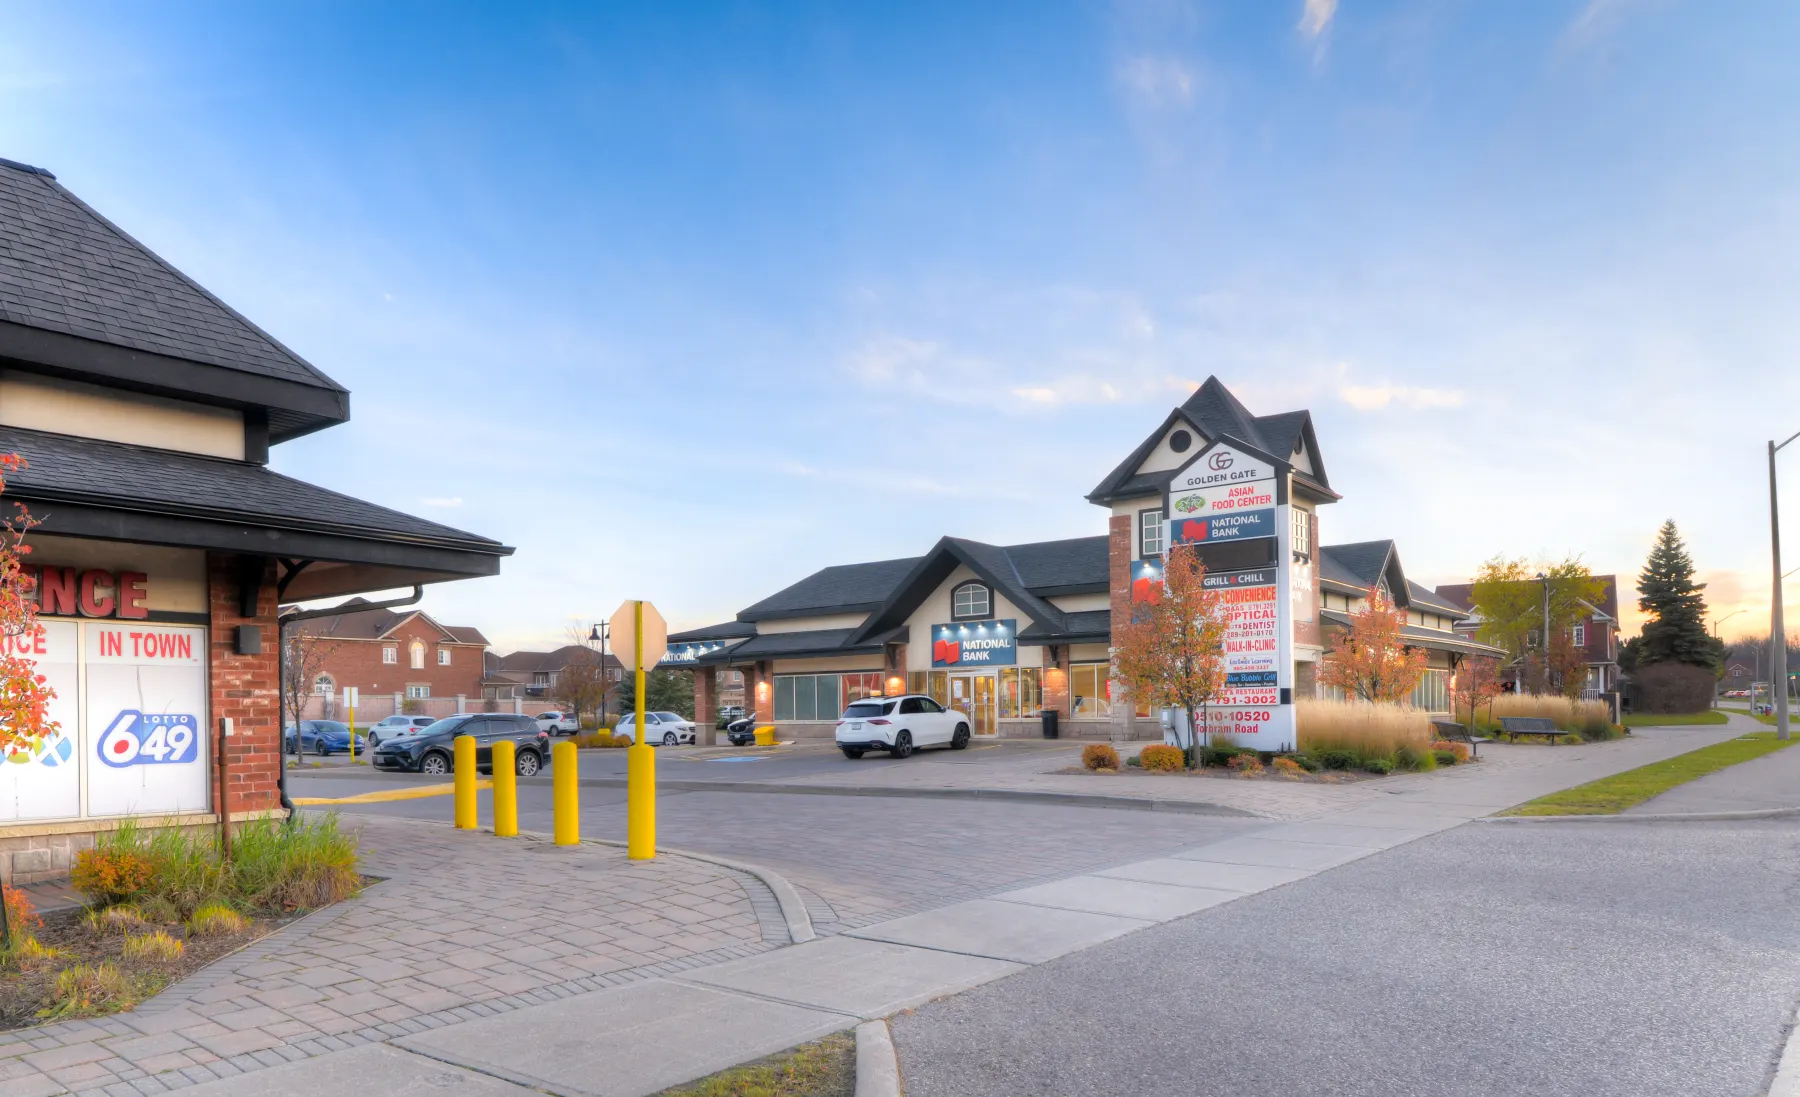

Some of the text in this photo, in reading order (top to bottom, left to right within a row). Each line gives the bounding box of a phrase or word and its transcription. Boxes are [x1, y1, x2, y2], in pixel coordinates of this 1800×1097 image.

[1187, 469, 1257, 486] GOLDEN GATE
[1228, 486, 1254, 498] ASIAN
[1212, 500, 1235, 510] FOOD
[1237, 494, 1272, 507] CENTER
[1211, 514, 1261, 528] NATIONAL
[1211, 527, 1240, 538] BANK
[1203, 576, 1229, 586] GRILL
[1238, 573, 1265, 583] CHILL
[1224, 586, 1276, 604] CONVENIENCE
[1242, 621, 1275, 630] DENTIST
[1226, 629, 1273, 638] 289-201-0170
[100, 631, 191, 659] IN TOWN
[962, 638, 1011, 650] NATIONAL
[1226, 638, 1276, 653] WALK-IN-CLINIC
[962, 650, 990, 661] BANK
[1236, 687, 1277, 695] RESTAURANT
[143, 716, 188, 724] LOTTO
[1234, 724, 1259, 733] Road
